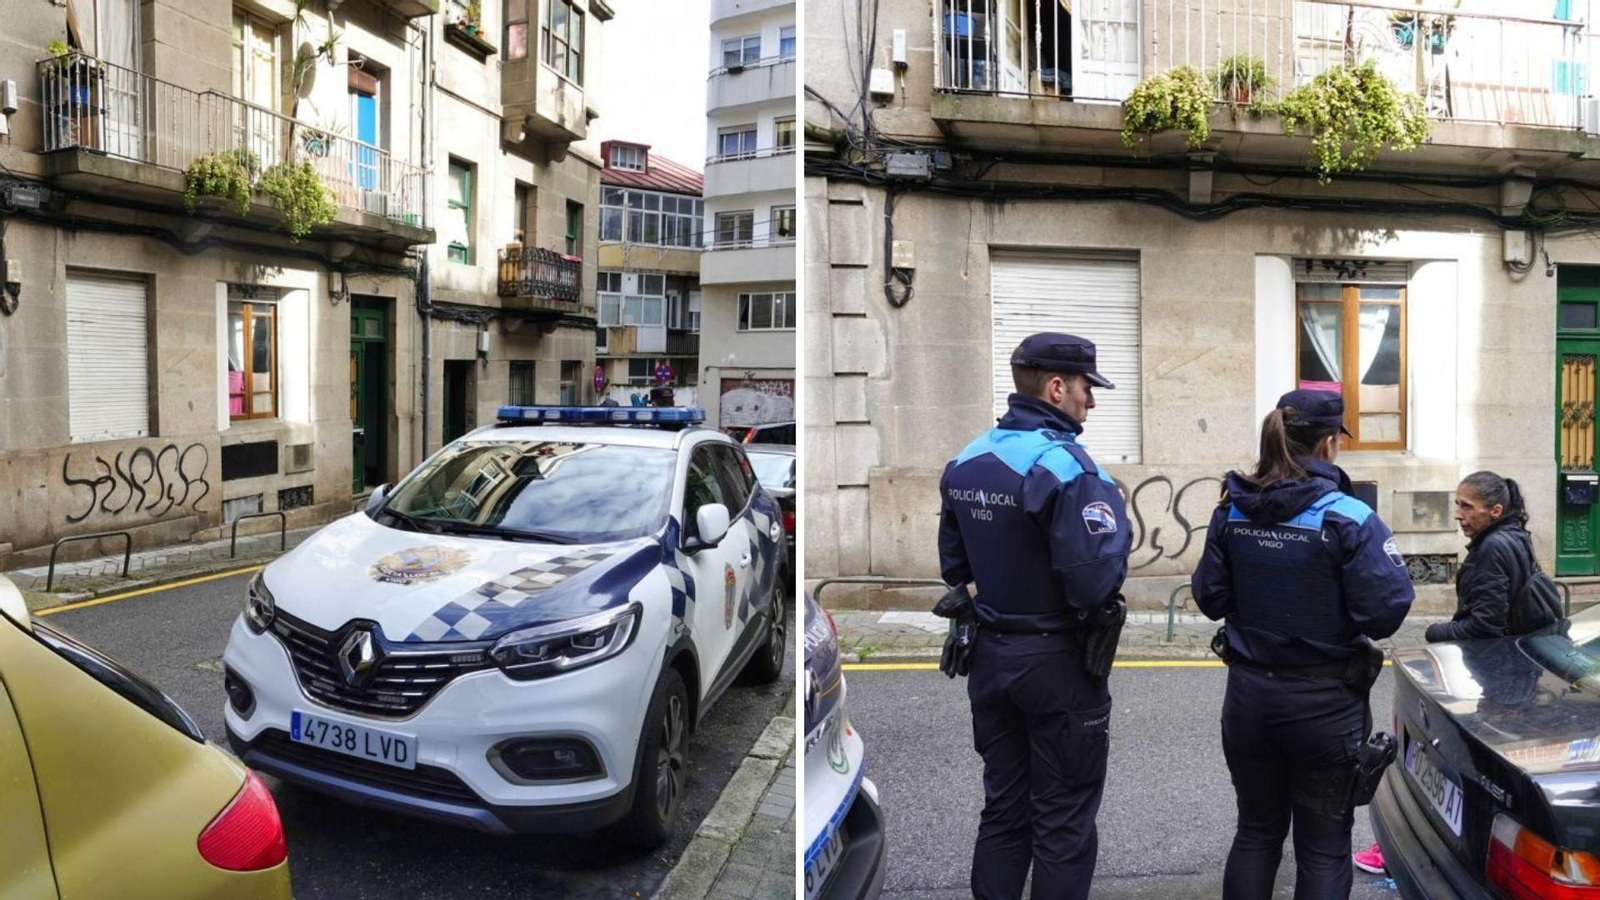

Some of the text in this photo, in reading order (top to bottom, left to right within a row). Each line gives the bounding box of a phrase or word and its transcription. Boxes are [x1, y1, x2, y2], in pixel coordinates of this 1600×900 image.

[986, 492, 1017, 507] LOCAL
[971, 508, 993, 521] VIGO
[1258, 540, 1284, 549] VIGO
[1278, 532, 1309, 543] LOCAL
[304, 719, 408, 763] 4738 LVD
[1421, 760, 1447, 806] 2596
